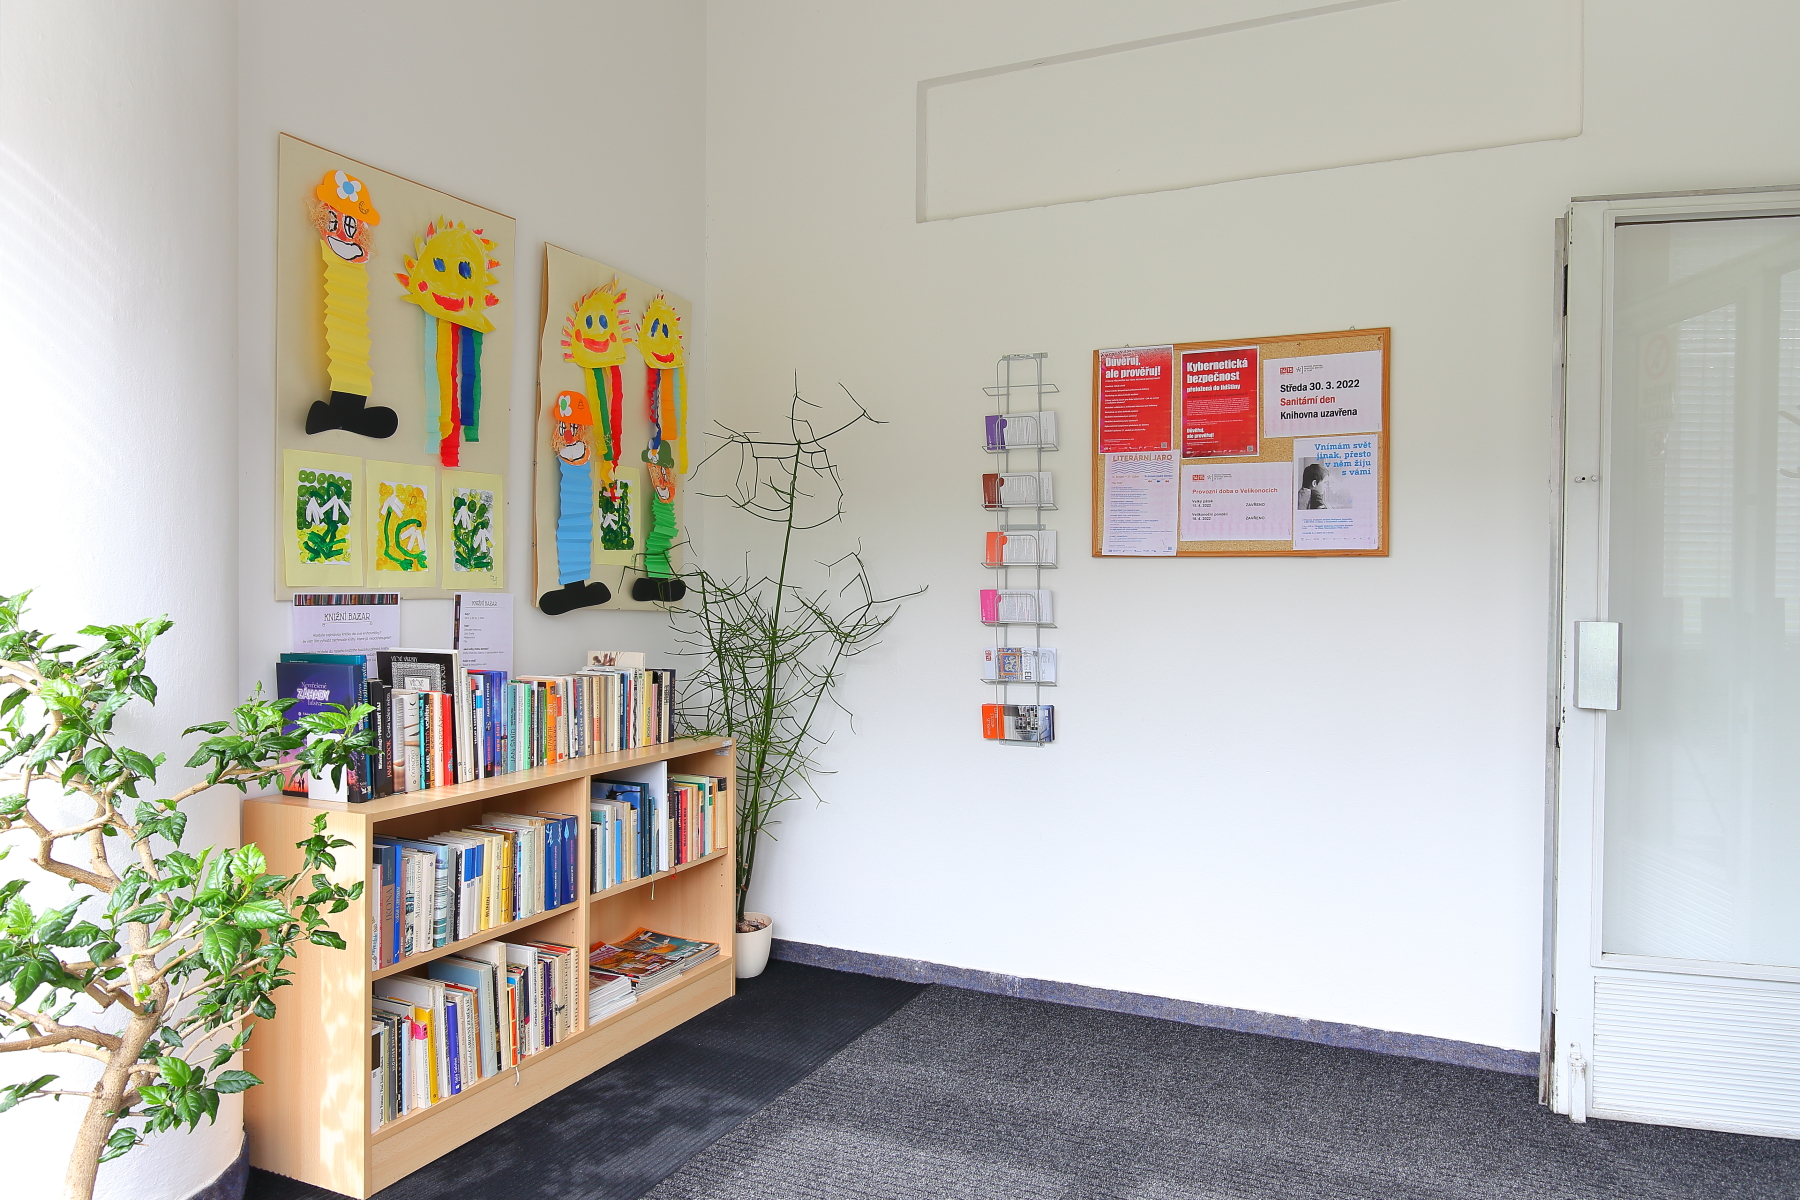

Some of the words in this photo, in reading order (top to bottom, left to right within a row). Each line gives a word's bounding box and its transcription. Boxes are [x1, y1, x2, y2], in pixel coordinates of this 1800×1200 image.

[1186, 358, 1248, 372] Kybernetická
[1106, 369, 1119, 378] ale
[1120, 366, 1161, 378] prověřuj!
[1186, 371, 1240, 384] bezpečnost
[1280, 383, 1307, 393] Středa
[1309, 382, 1324, 391] 30.
[1326, 381, 1334, 390] 3.
[1336, 379, 1360, 389] 2022
[1280, 396, 1318, 406] Sanitární
[1280, 411, 1318, 420] Knihovna
[1320, 407, 1357, 418] uzavřena
[1112, 453, 1151, 461] LITERÁRNÍ
[1316, 452, 1341, 460] jinak,
[1344, 451, 1371, 459] přesto
[324, 611, 346, 621] KNIŽNÍ
[348, 612, 370, 621] BAZAR
[297, 687, 330, 701] ZÁHADY
